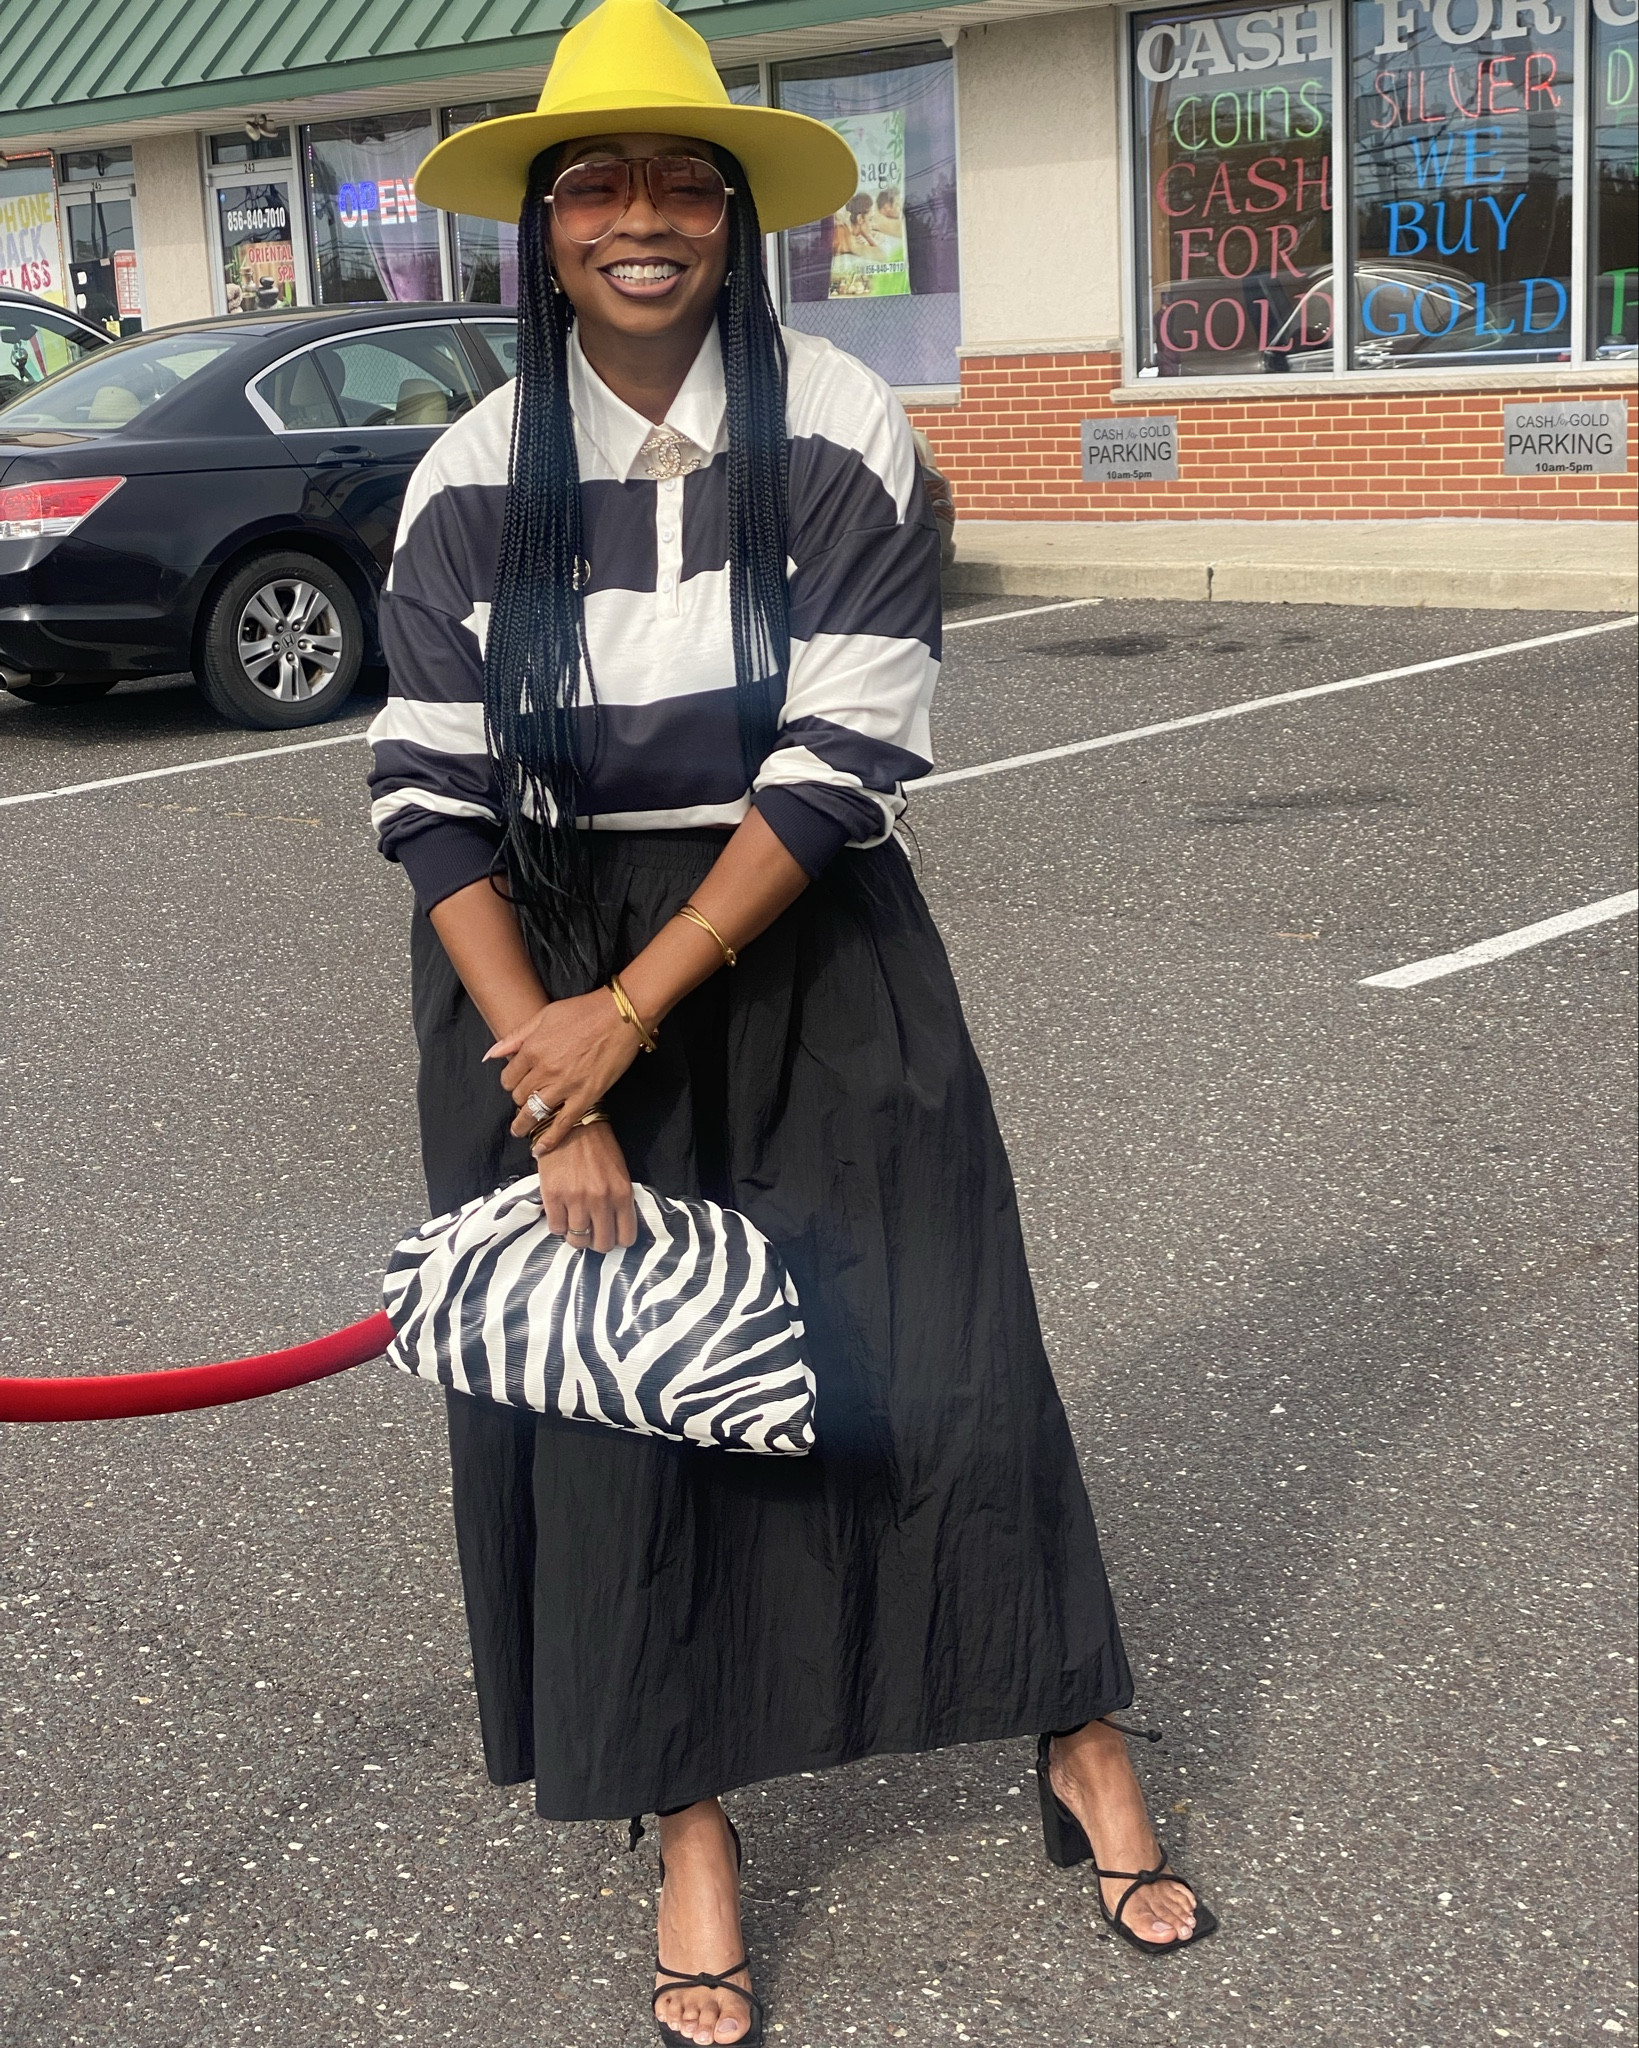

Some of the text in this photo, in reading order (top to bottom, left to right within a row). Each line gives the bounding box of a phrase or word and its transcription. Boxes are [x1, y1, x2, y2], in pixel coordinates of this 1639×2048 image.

[1137, 0, 1562, 82] CASH FOR
[1371, 52, 1561, 129] SILVER
[244, 163, 255, 173] 243
[1408, 126, 1505, 189] WE
[860, 160, 898, 189] sage
[1156, 156, 1332, 217] CASH
[0, 192, 53, 233] HONE
[338, 178, 417, 228] OPEN
[227, 207, 286, 231] 856-840-7010
[1382, 193, 1527, 257] BUY
[248, 244, 294, 264] ORIENTAL
[1174, 224, 1307, 281] FOR
[277, 264, 295, 283] SPA
[1160, 291, 1333, 352] GOLD
[1362, 277, 1567, 337] GOLD
[1093, 428, 1123, 441] CASH
[1139, 424, 1171, 438] GOLD
[1516, 415, 1553, 429] CASH
[1570, 413, 1609, 427] GOLD
[1088, 441, 1172, 465] PARKING
[1508, 433, 1613, 455] PARKING
[1106, 469, 1152, 480] 10am-5pm
[1535, 461, 1593, 474] 10am-5pm
